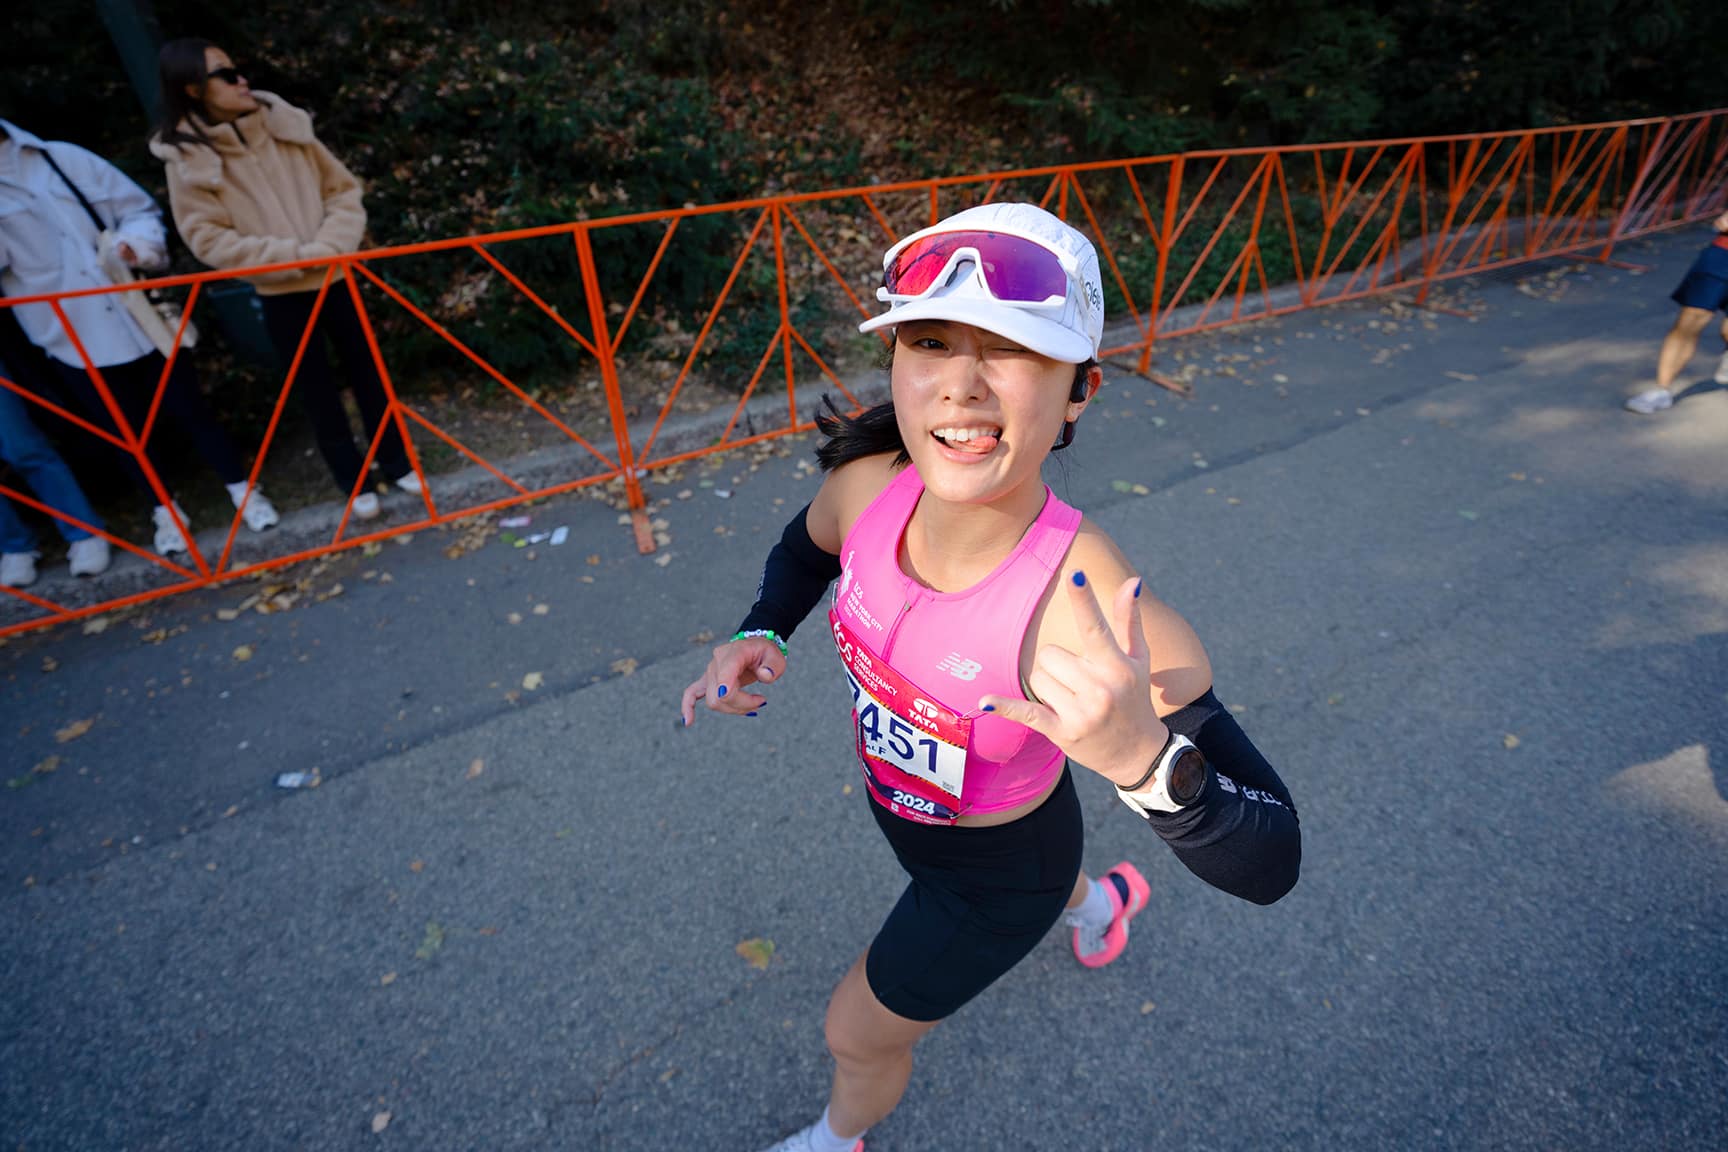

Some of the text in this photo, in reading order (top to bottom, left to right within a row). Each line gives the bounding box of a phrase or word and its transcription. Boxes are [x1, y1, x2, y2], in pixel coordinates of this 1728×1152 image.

[856, 646, 873, 669] TATA
[853, 662, 879, 692] SERVICES
[854, 655, 898, 697] CONSULTANCY
[907, 708, 939, 733] TATA
[892, 790, 936, 816] 2024
